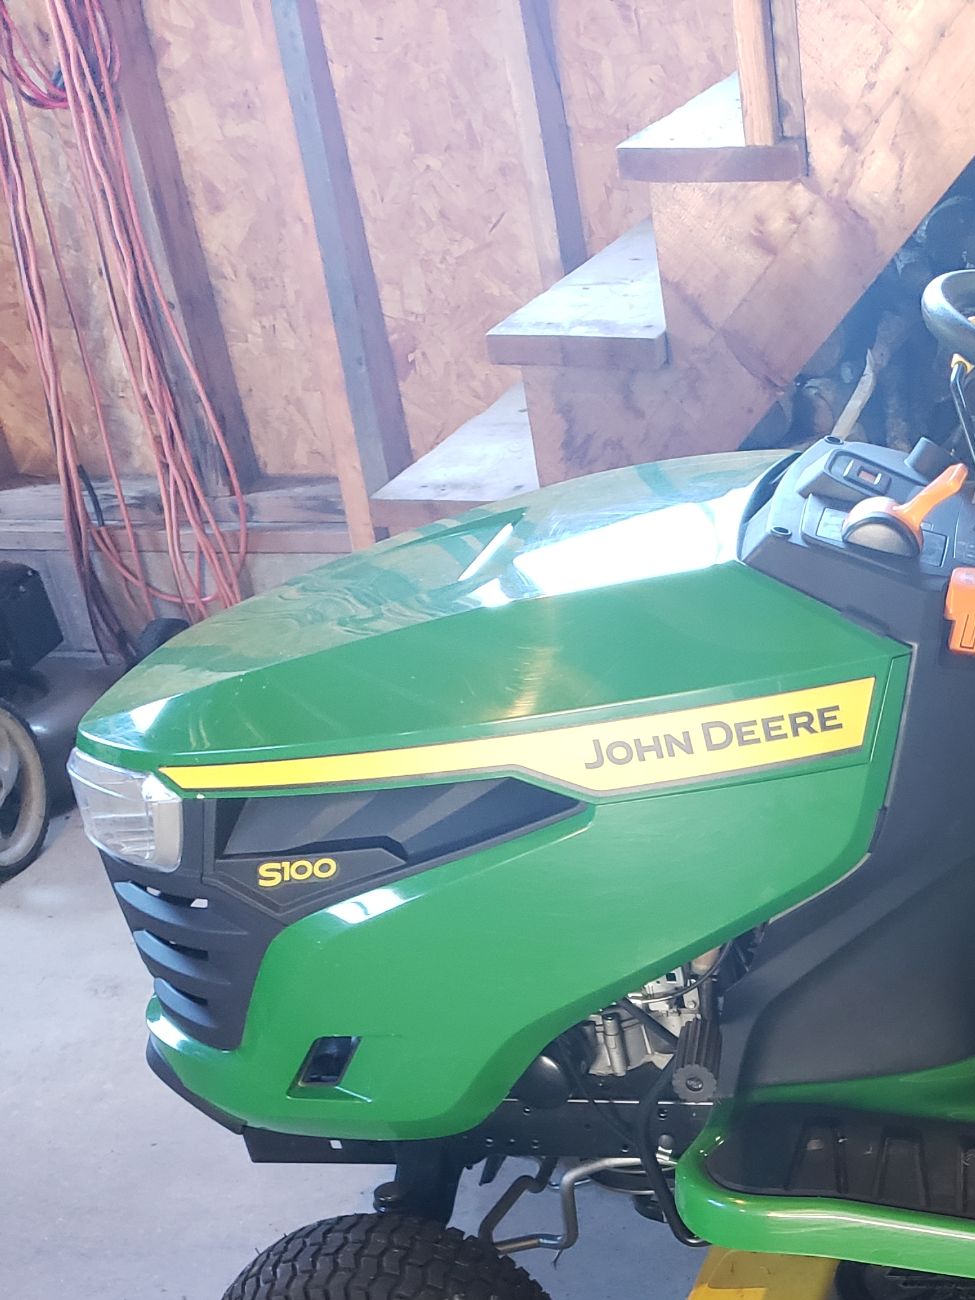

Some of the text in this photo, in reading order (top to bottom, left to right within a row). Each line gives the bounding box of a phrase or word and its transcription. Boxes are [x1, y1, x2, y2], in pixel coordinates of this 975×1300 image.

[584, 705, 843, 769] JOHN DEERE
[258, 857, 337, 887] S100
